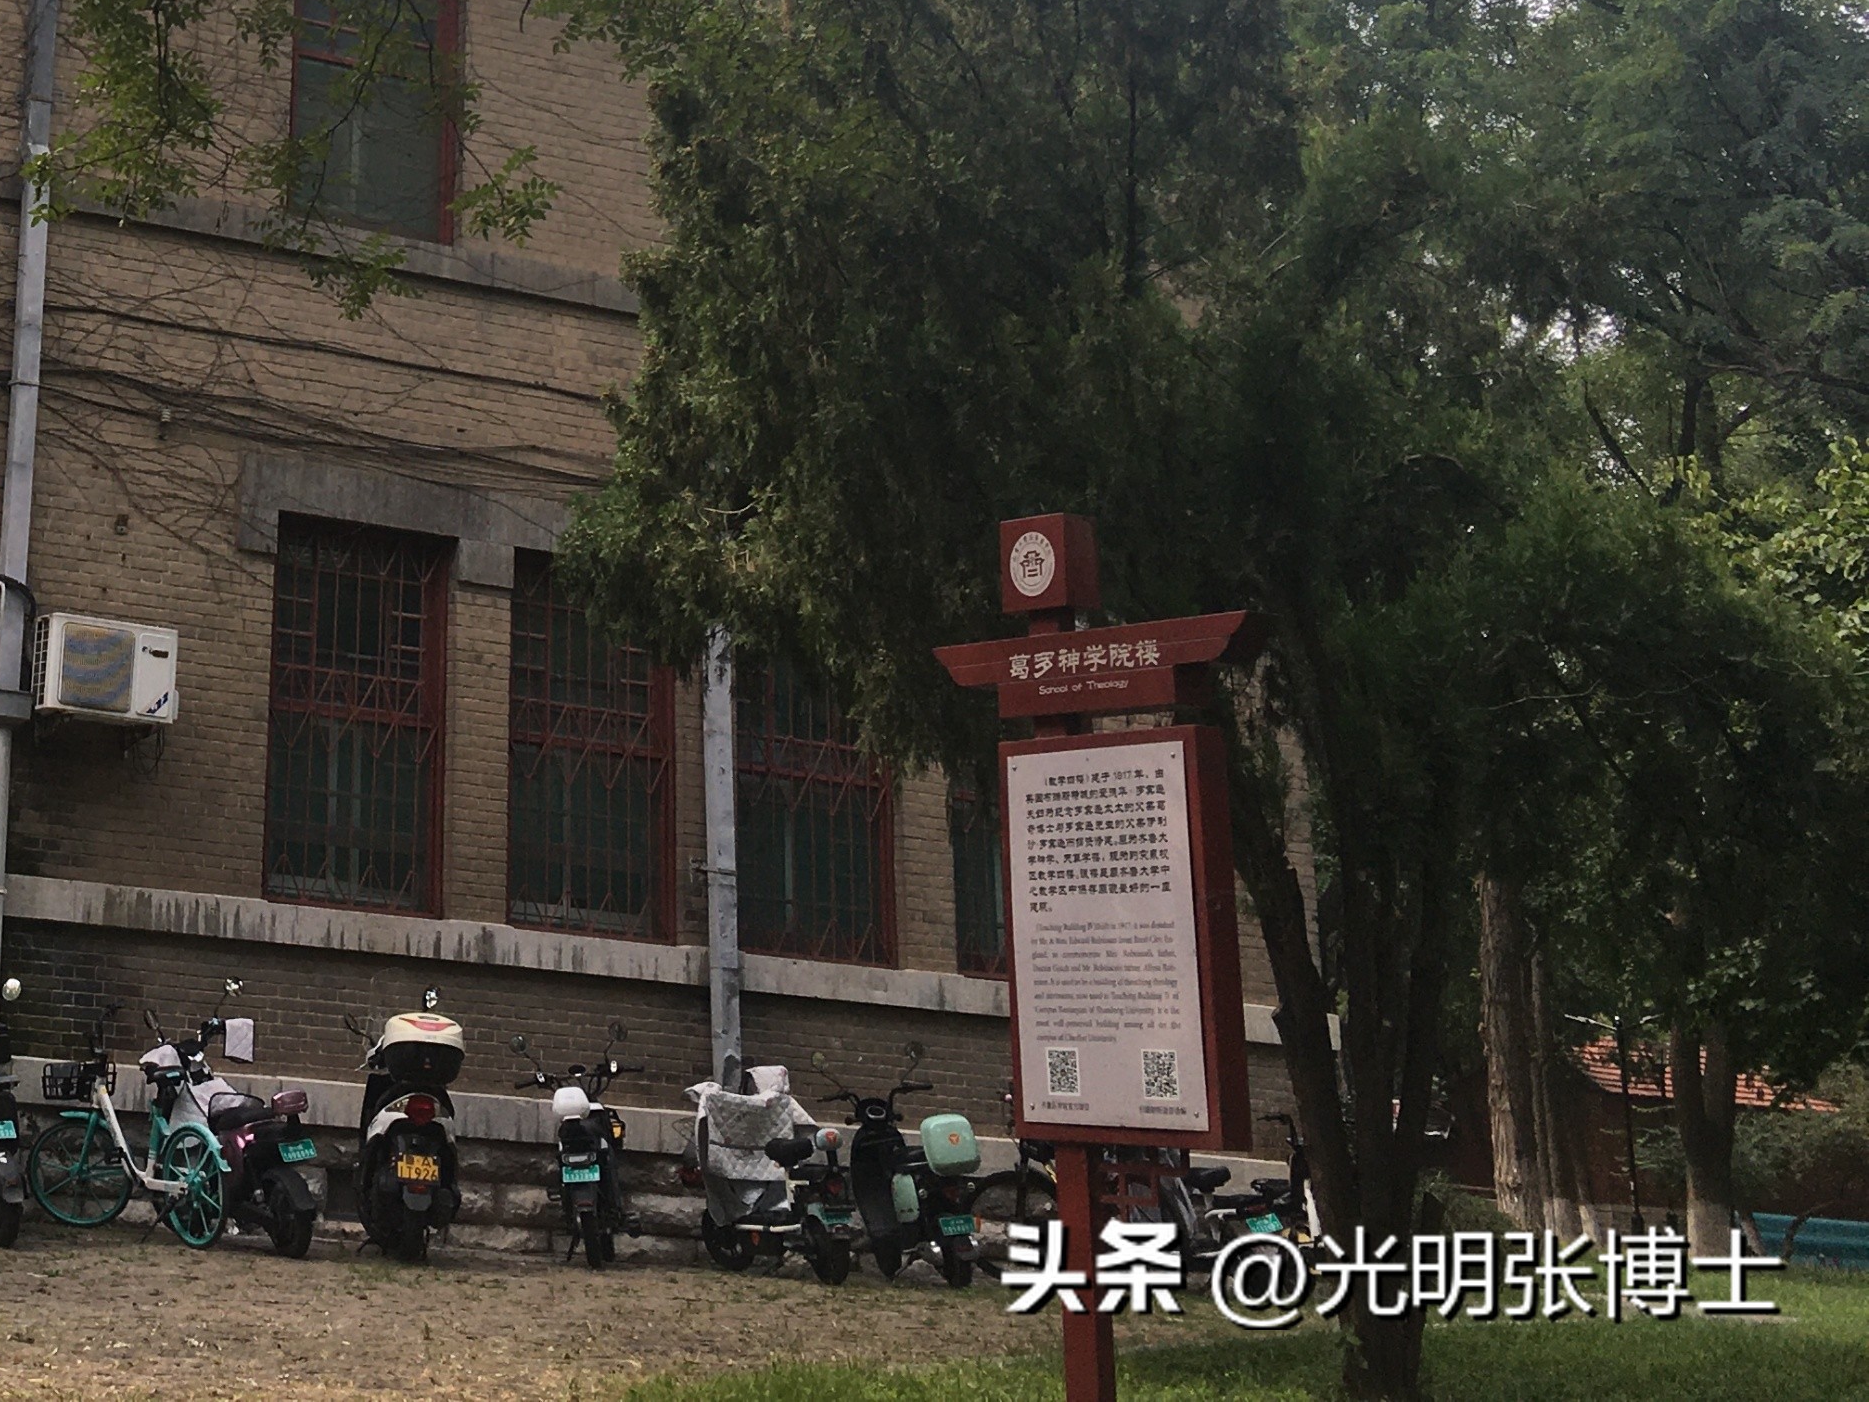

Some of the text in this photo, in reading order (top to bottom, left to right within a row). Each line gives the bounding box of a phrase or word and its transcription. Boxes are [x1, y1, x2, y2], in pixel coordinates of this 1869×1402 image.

[1038, 678, 1129, 695] School of Theology
